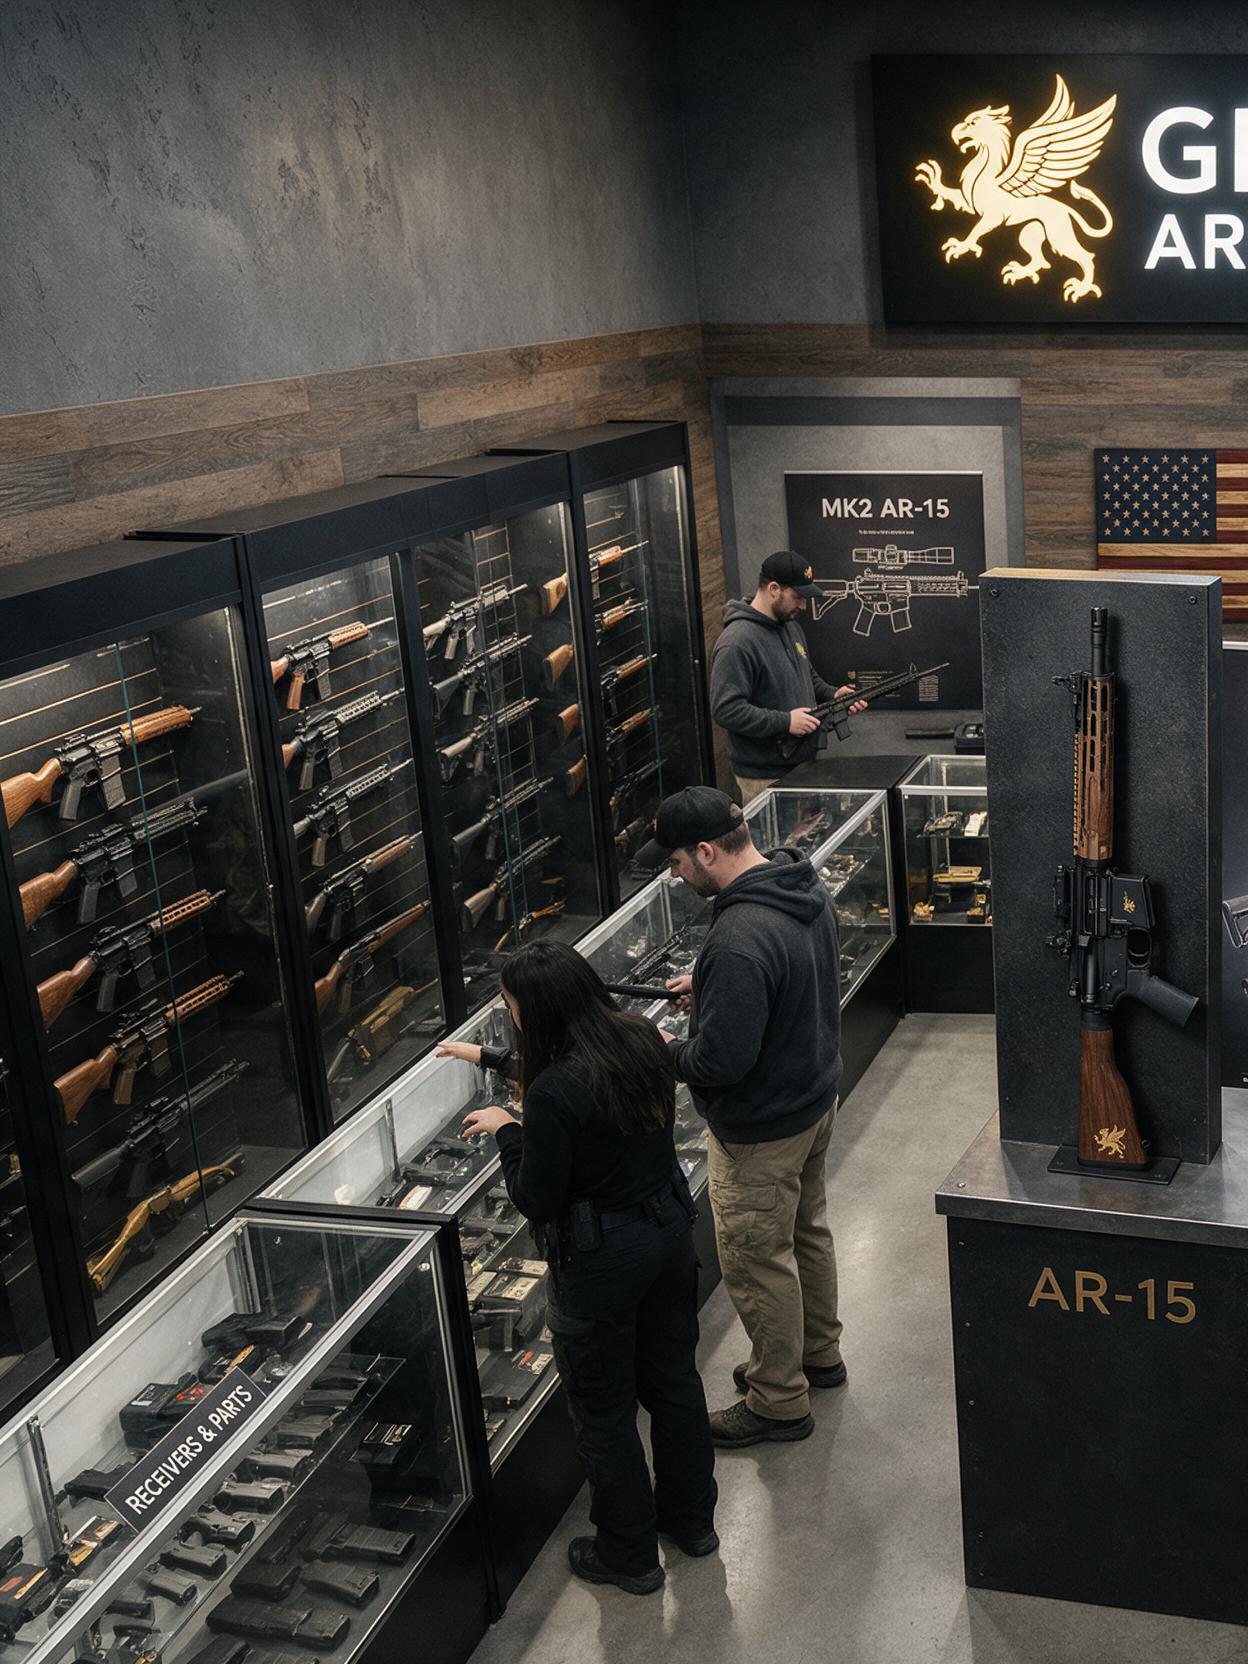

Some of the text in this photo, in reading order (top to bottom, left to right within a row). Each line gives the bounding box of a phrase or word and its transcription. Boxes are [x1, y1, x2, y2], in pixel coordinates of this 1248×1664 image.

[822, 497, 950, 519] MK2 AR-15
[1028, 1266, 1197, 1325] AR-15
[125, 1385, 252, 1515] RECEIVERS & PARTS
